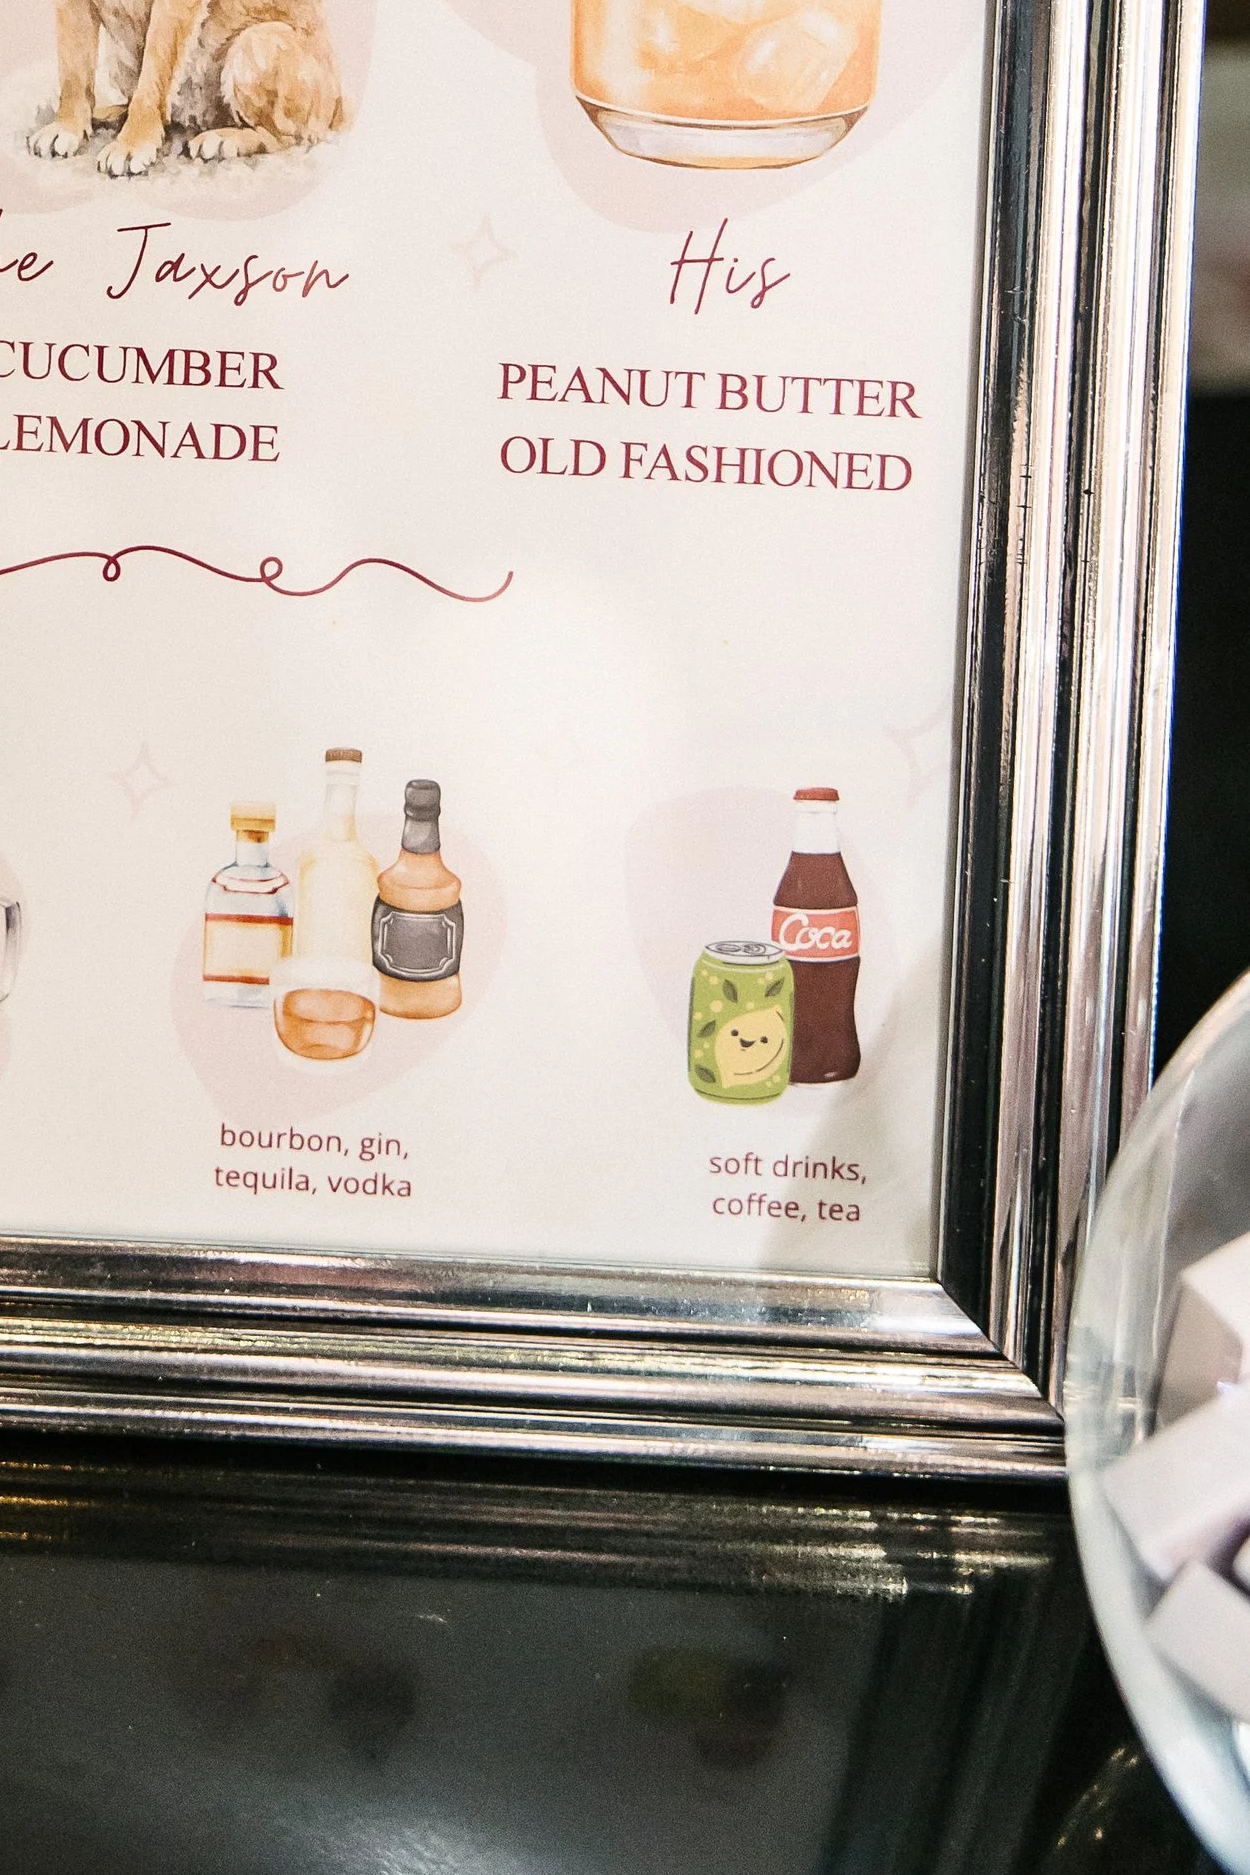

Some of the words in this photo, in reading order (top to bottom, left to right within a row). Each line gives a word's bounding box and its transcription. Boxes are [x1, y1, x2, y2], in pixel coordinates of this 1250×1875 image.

[106, 222, 350, 307] Jaxson
[669, 217, 791, 315] His
[498, 362, 706, 409] PEANUT
[717, 372, 922, 419] BUTTER
[500, 435, 607, 477] OLD
[620, 441, 912, 491] FASHIONED
[778, 913, 852, 951] Coca
[220, 1122, 349, 1157] bourbon,
[358, 1137, 408, 1162] gin,
[214, 1166, 317, 1196] tequila,
[327, 1172, 412, 1198] vodka
[709, 1151, 763, 1177] soft
[773, 1155, 867, 1185] drinks,
[712, 1192, 807, 1223] coffee,
[818, 1199, 860, 1222] tea
